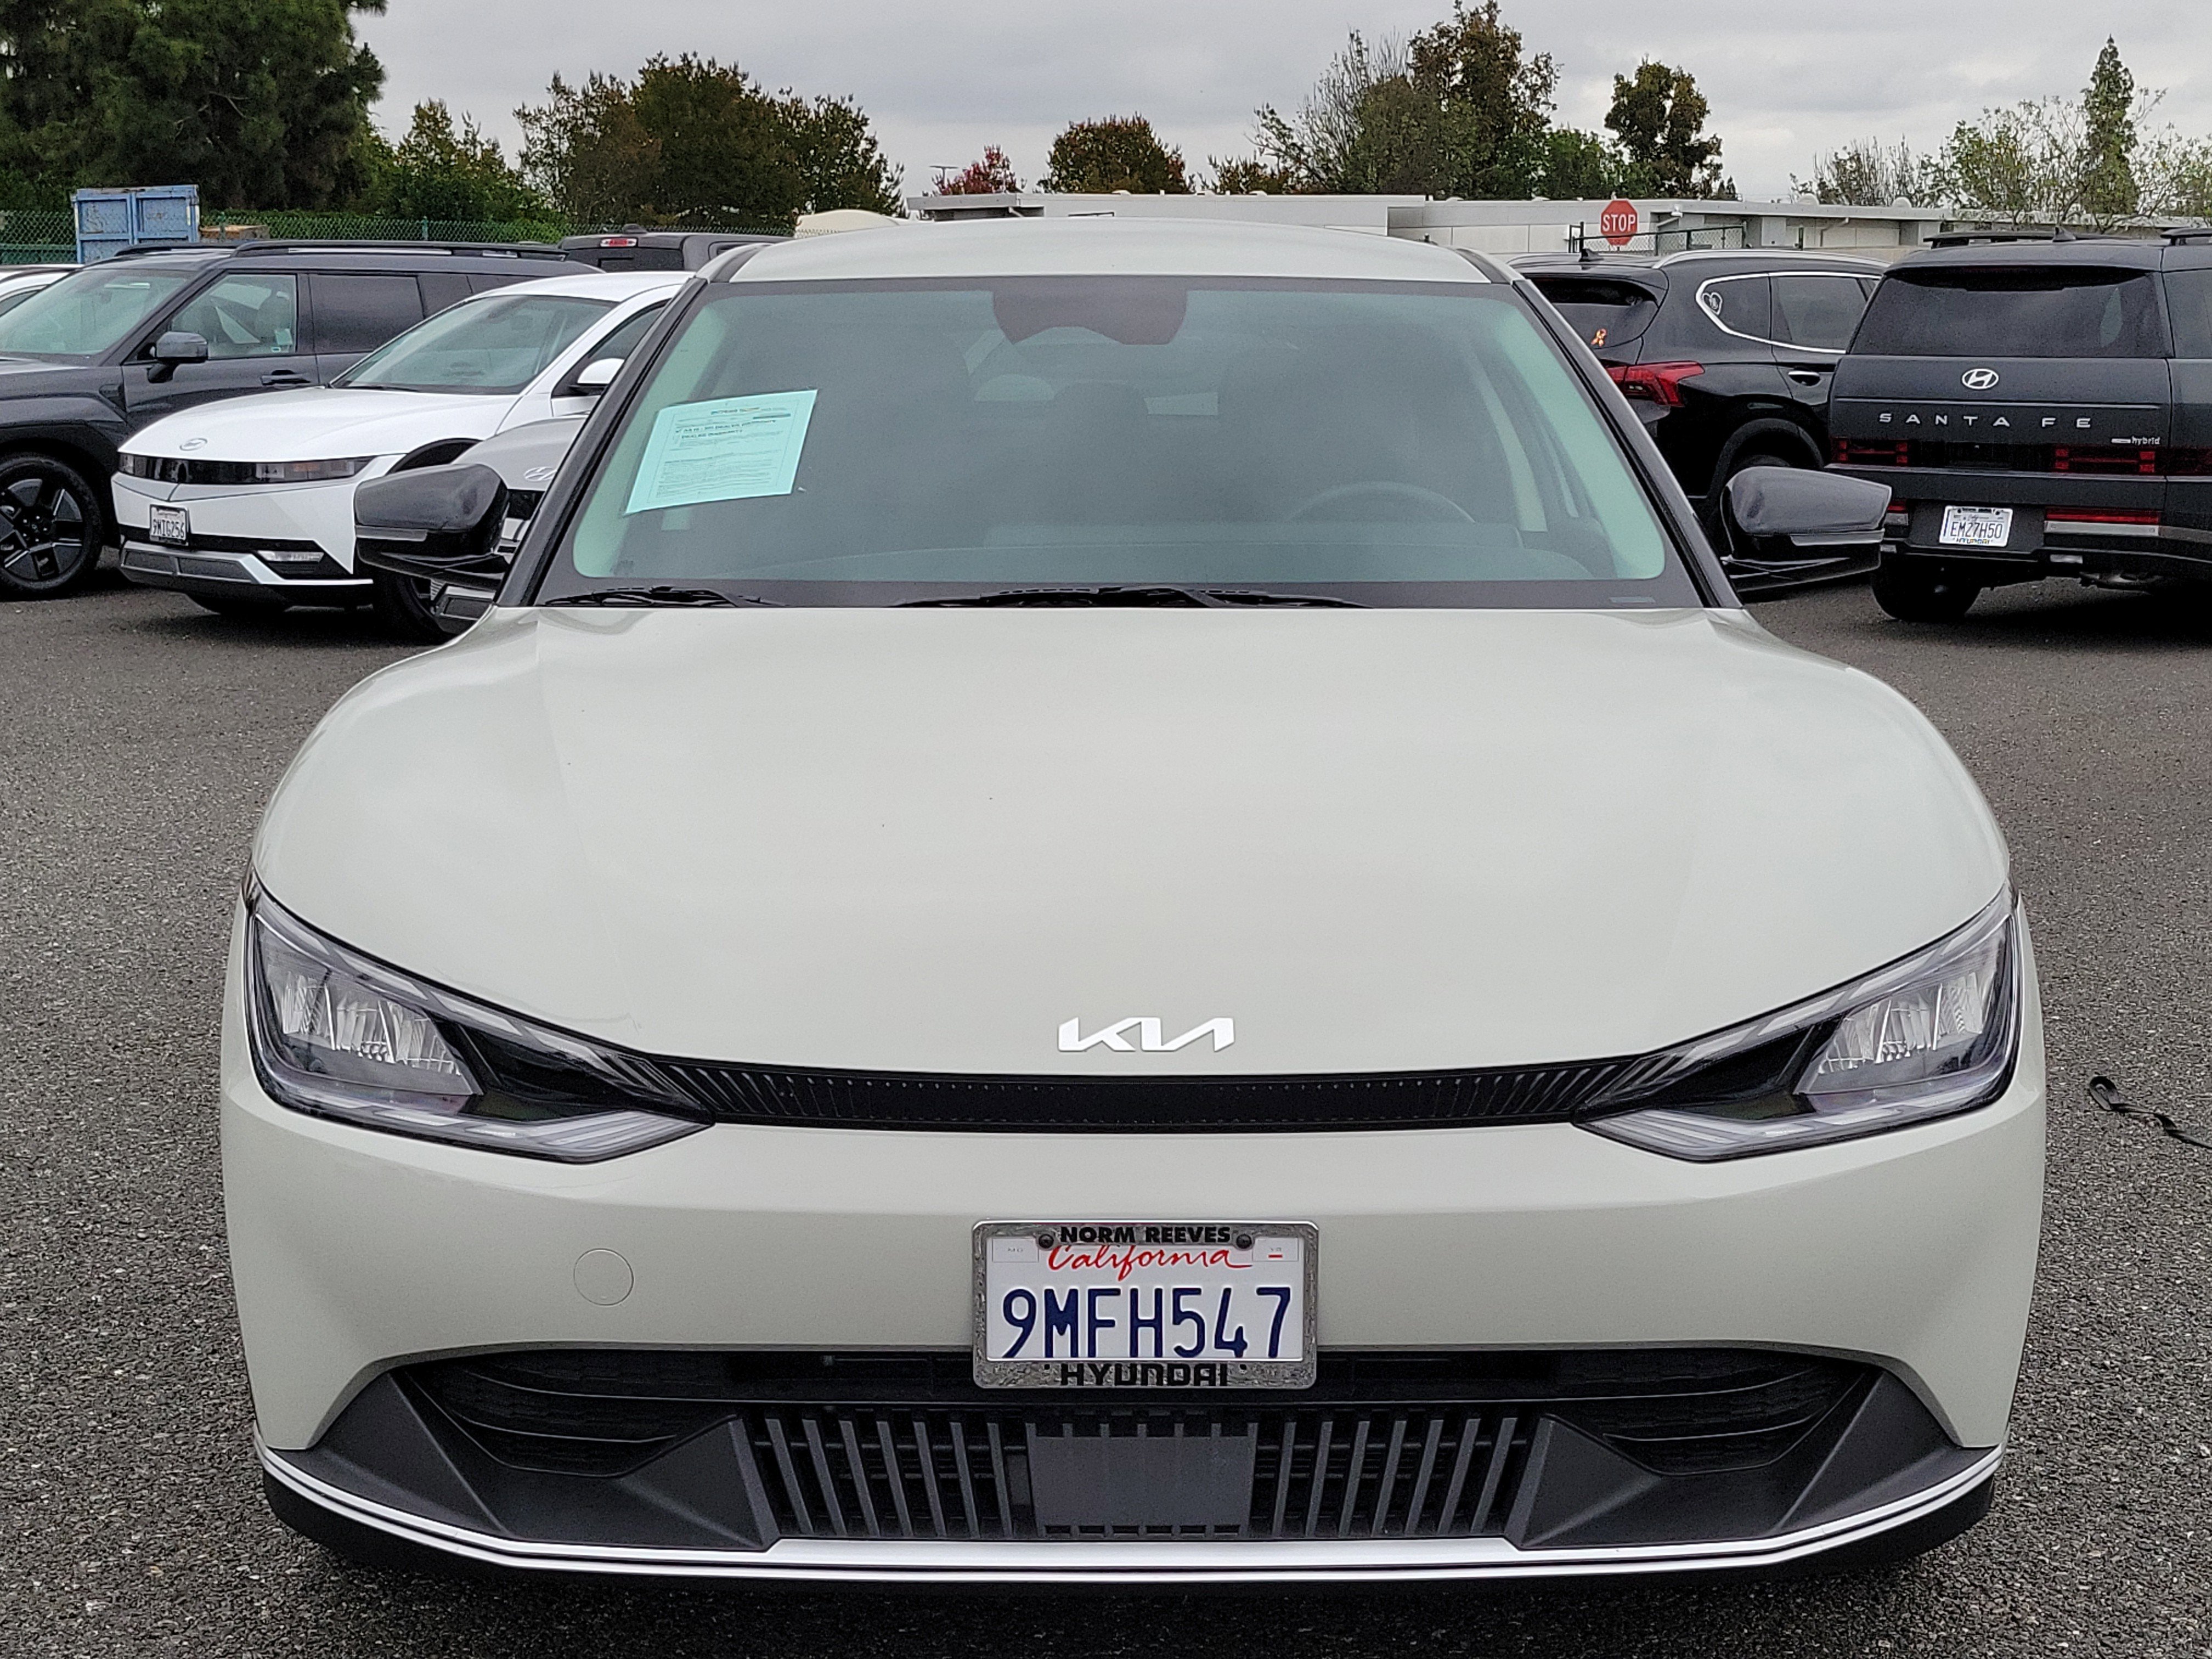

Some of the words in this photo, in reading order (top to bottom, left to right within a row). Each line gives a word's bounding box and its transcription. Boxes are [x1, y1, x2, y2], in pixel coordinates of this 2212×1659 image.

[1602, 214, 1636, 232] STOP
[1879, 413, 2010, 427] SANTA
[2041, 417, 2091, 428] FE
[1950, 521, 2003, 539] EM27H50
[1058, 1016, 1235, 1052] KIA
[1060, 1226, 1136, 1243] NORM
[1145, 1226, 1231, 1243] REEVES
[1048, 1244, 1252, 1282] California
[1002, 1286, 1291, 1358] 9MFH547
[1060, 1363, 1228, 1386] HYUNDAI
